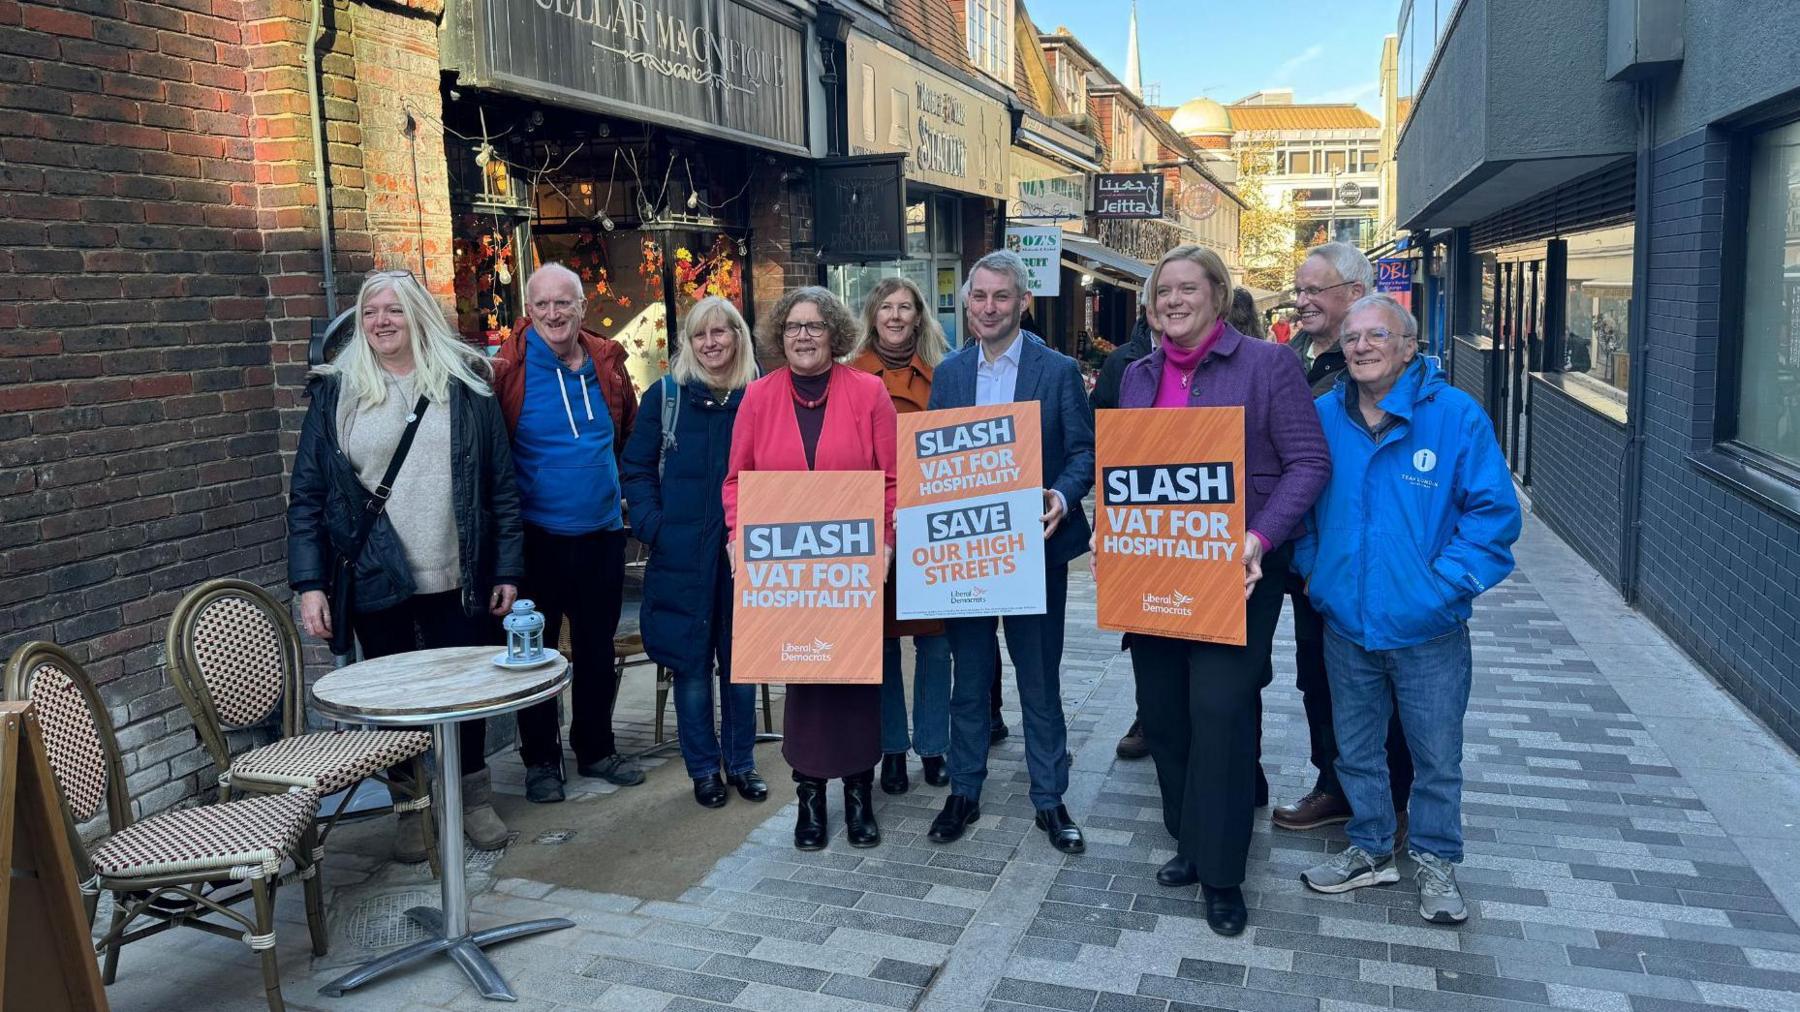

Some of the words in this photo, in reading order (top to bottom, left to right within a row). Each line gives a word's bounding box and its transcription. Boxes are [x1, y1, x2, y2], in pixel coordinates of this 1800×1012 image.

[535, 0, 649, 44] LLAR
[656, 10, 785, 88] MAGNIFIQUE
[1098, 199, 1147, 213] Jeitta
[1380, 262, 1410, 280] DBL
[919, 420, 1014, 456] SLASH
[919, 458, 963, 481] VAT
[969, 450, 1015, 473] FOR
[919, 467, 1022, 497] HOSPITALITY
[1108, 465, 1229, 504] SLASH
[932, 504, 1007, 539] SAVE
[1106, 507, 1164, 535] VAT
[1170, 511, 1231, 539] FOR
[750, 522, 870, 558] SLASH
[911, 541, 960, 567] OUR
[966, 533, 1025, 557] HIGH
[1103, 534, 1237, 562] HOSPITALITY
[746, 563, 806, 588] VAT
[812, 562, 871, 588] FOR
[924, 556, 1017, 585] STREETS
[741, 590, 877, 609] HOSPITALITY
[950, 590, 972, 598] Liberal
[950, 596, 986, 604] Democrats
[1142, 592, 1172, 604] Liberal
[1142, 602, 1193, 616] Democrats
[781, 642, 812, 653] Liberal
[781, 652, 832, 662] Democrats
